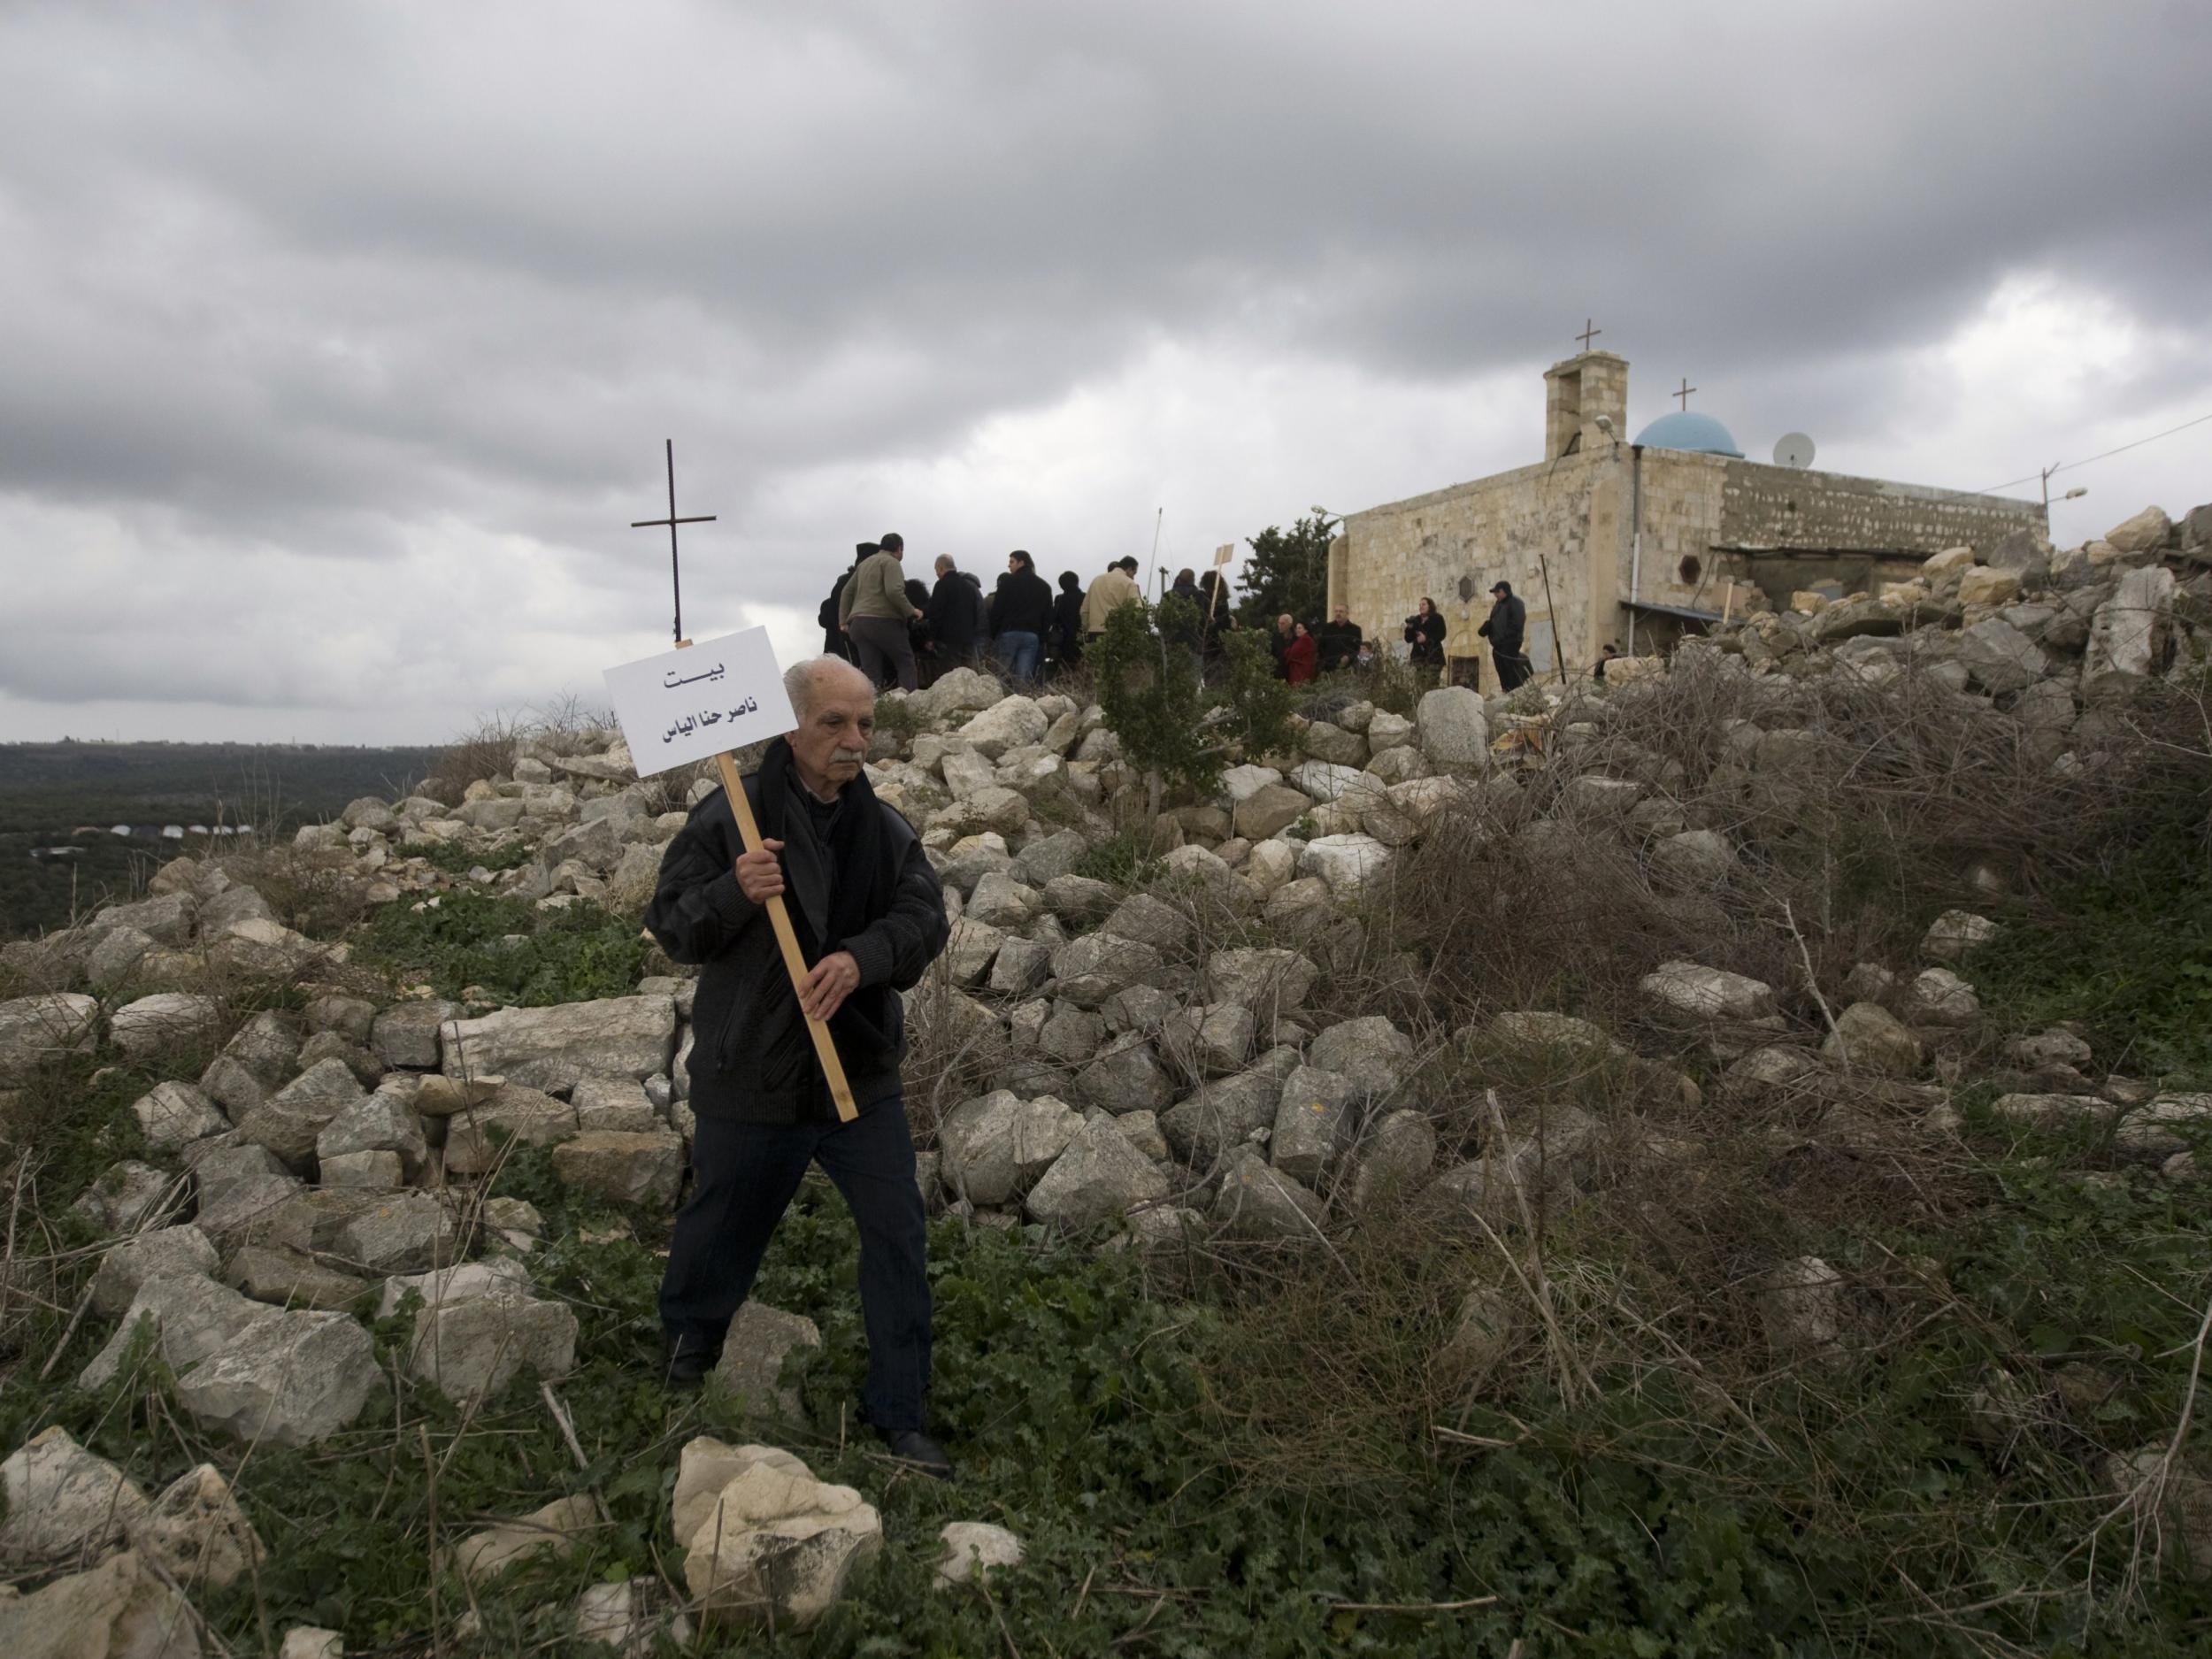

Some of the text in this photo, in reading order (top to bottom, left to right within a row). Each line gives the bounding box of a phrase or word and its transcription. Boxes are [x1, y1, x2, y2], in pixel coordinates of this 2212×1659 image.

[664, 663, 726, 689] بيت
[663, 696, 758, 743] ناصر حنا الياس
